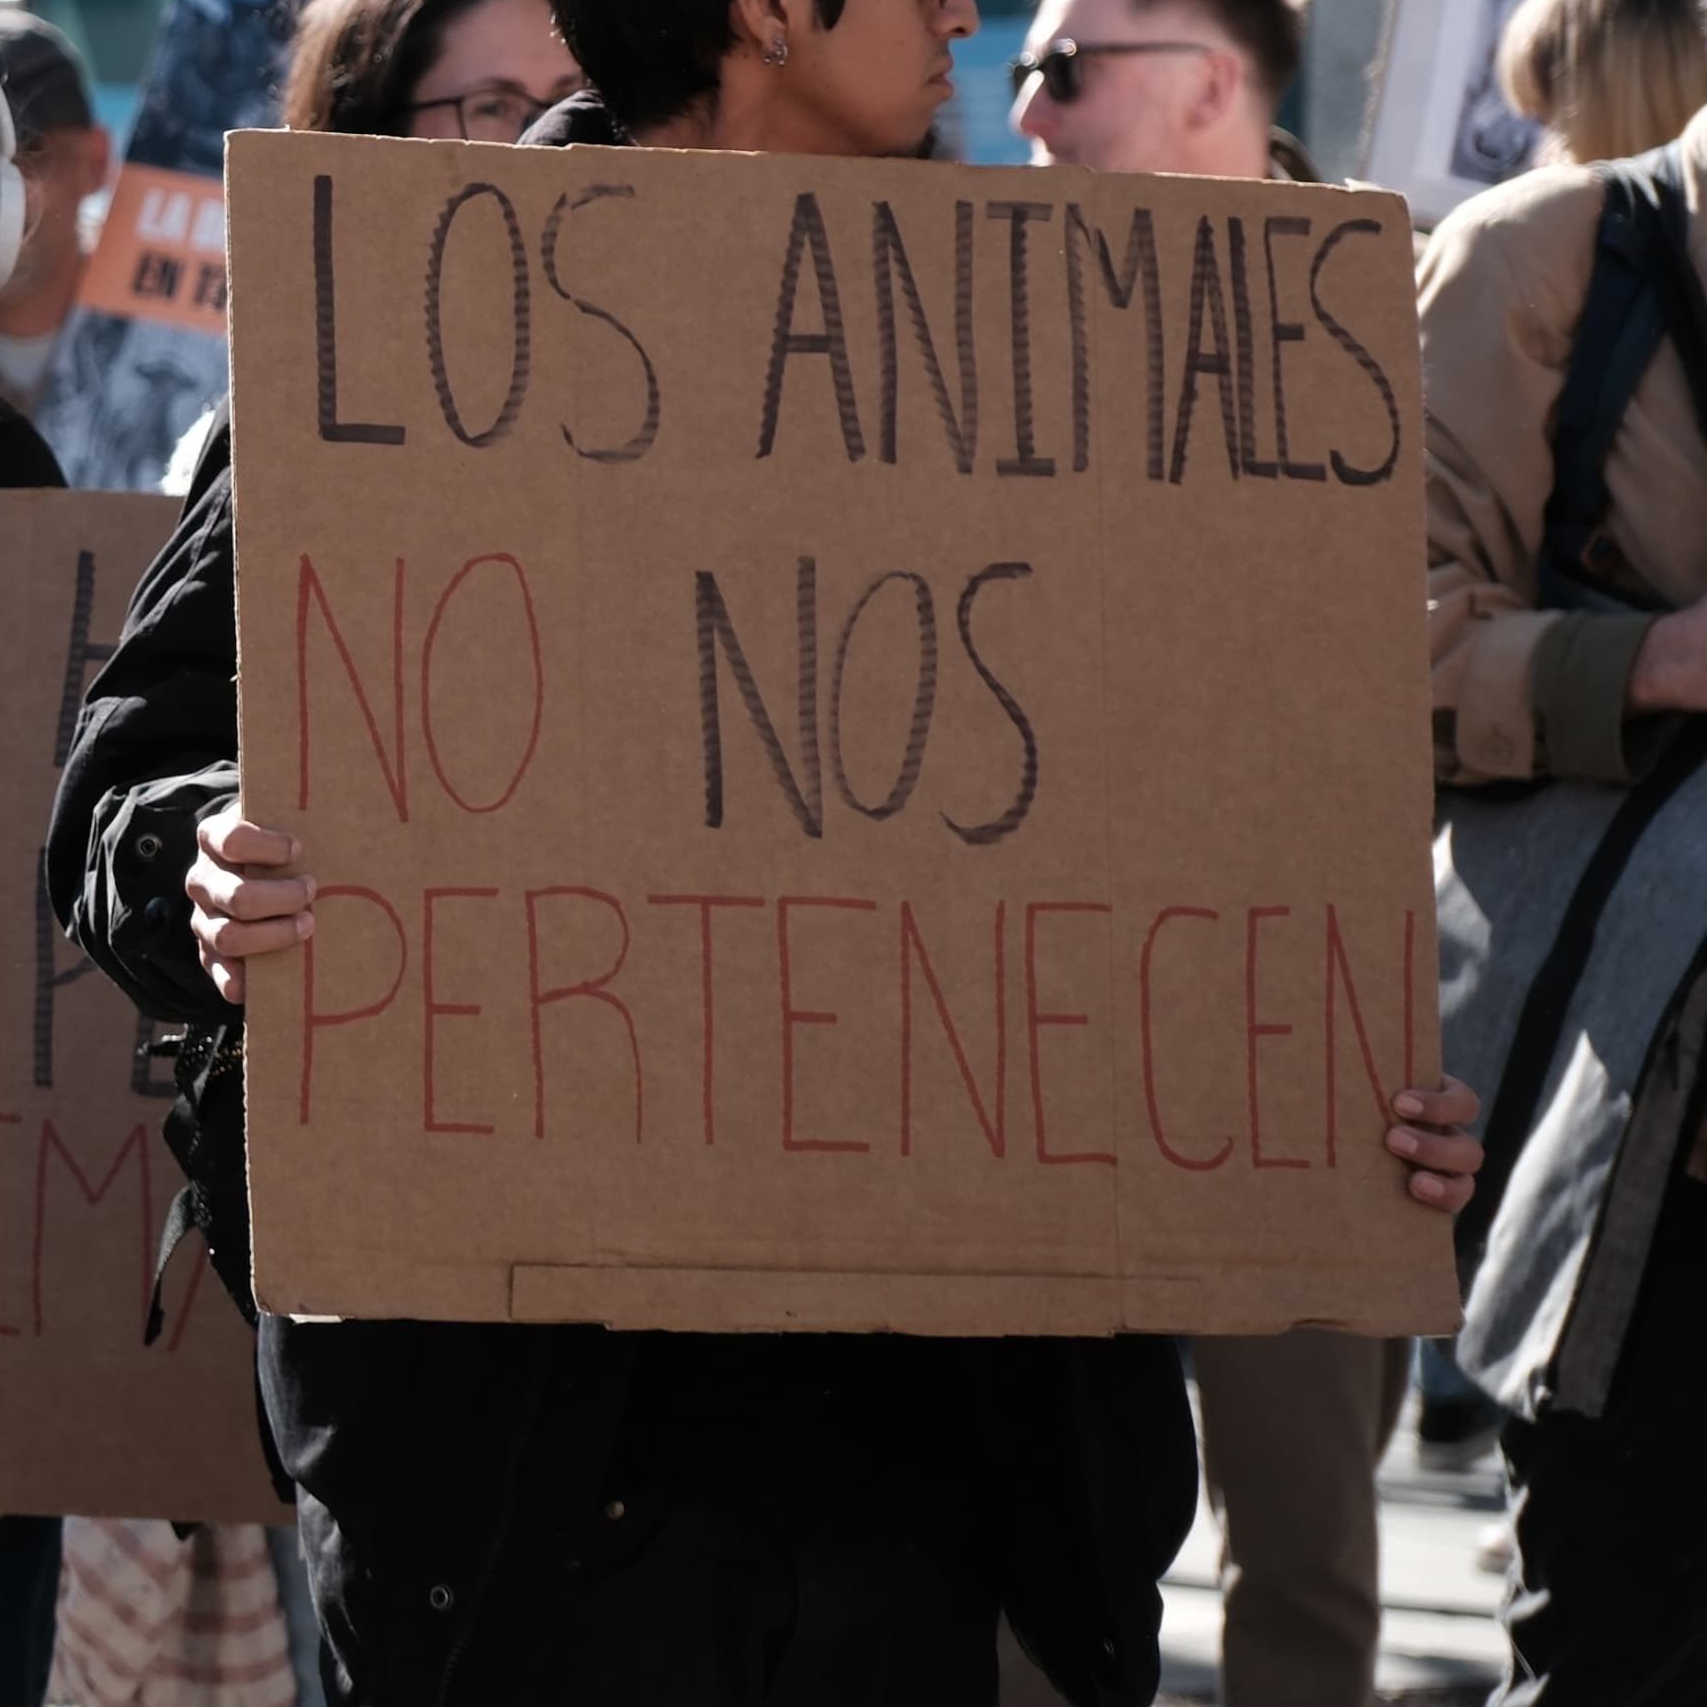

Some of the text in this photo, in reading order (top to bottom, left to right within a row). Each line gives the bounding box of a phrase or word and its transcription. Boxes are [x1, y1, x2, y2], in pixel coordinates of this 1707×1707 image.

[314, 175, 1402, 488] LOS ANIMALES
[296, 551, 545, 824] NO
[694, 556, 1039, 846] NOS
[296, 884, 1416, 1171] PERTENECEN
